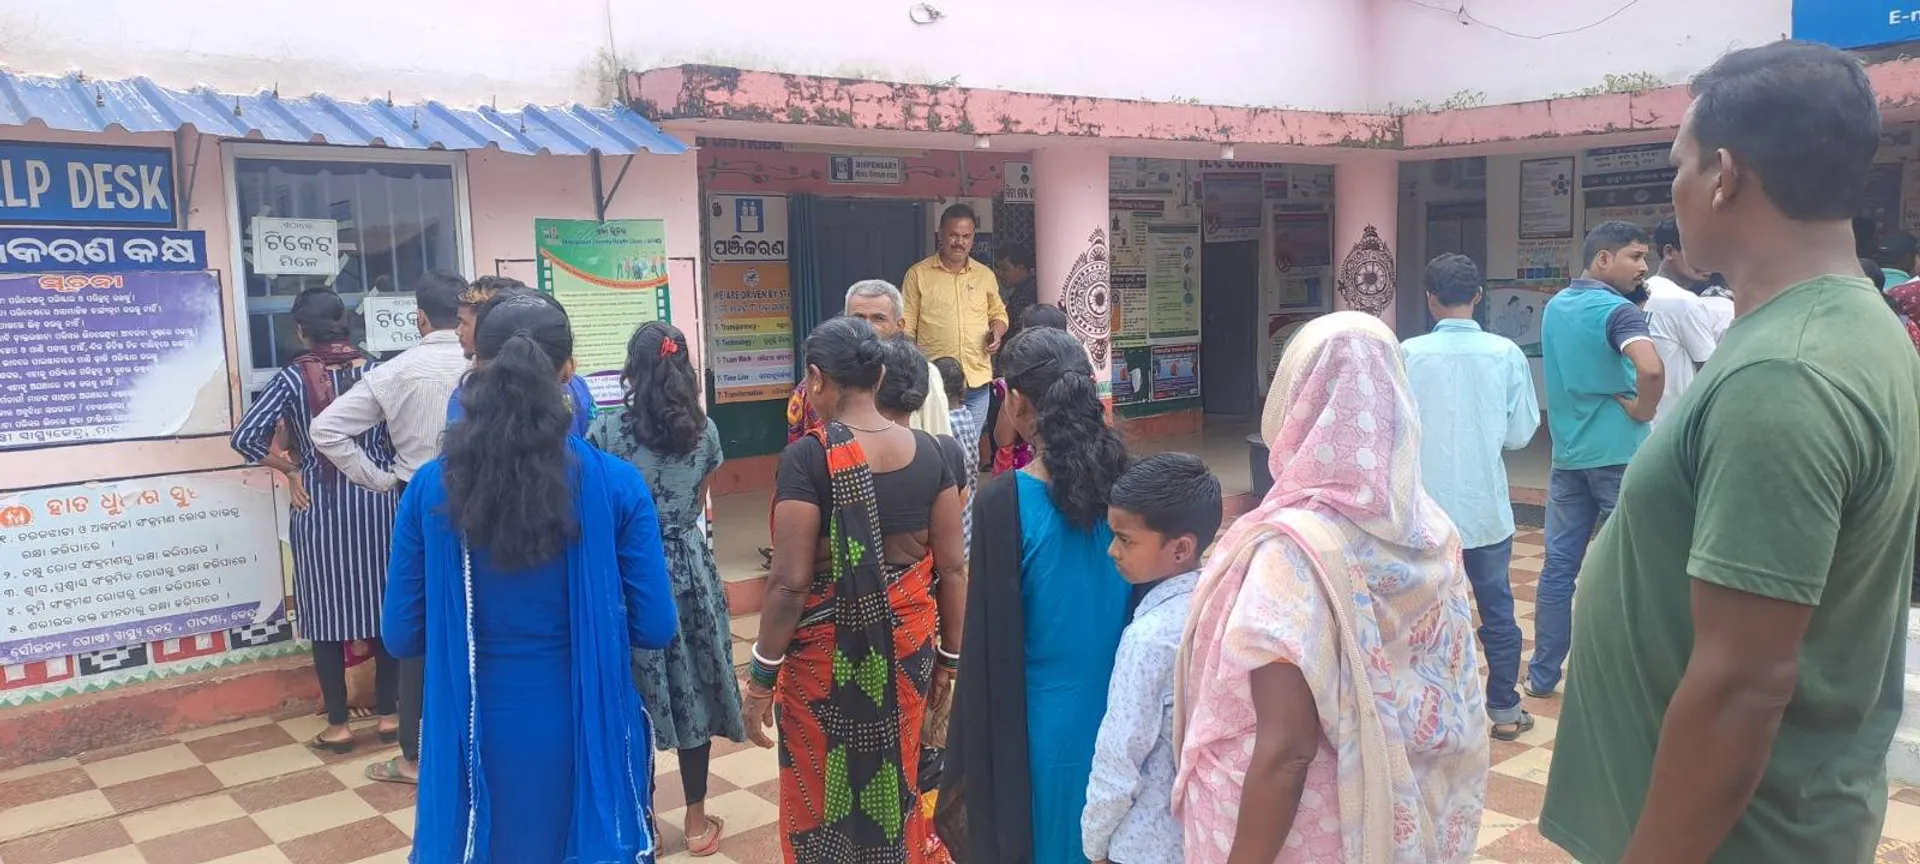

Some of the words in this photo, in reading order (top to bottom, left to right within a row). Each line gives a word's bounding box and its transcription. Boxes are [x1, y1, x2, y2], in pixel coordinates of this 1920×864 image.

[0, 159, 50, 208] LP
[67, 161, 169, 210] DESK
[263, 231, 333, 256] ଟିକେଟ୍
[726, 290, 739, 300] ARE
[741, 289, 768, 300] DRIVEN
[50, 541, 100, 556] କରିପାରେ
[47, 562, 77, 574] ରୋଗ
[162, 544, 208, 558] କରିପାରେ
[203, 556, 247, 570] କରିପାରେ
[165, 578, 211, 591] କରିପାରେ
[174, 594, 219, 607] କରିପାରେ
